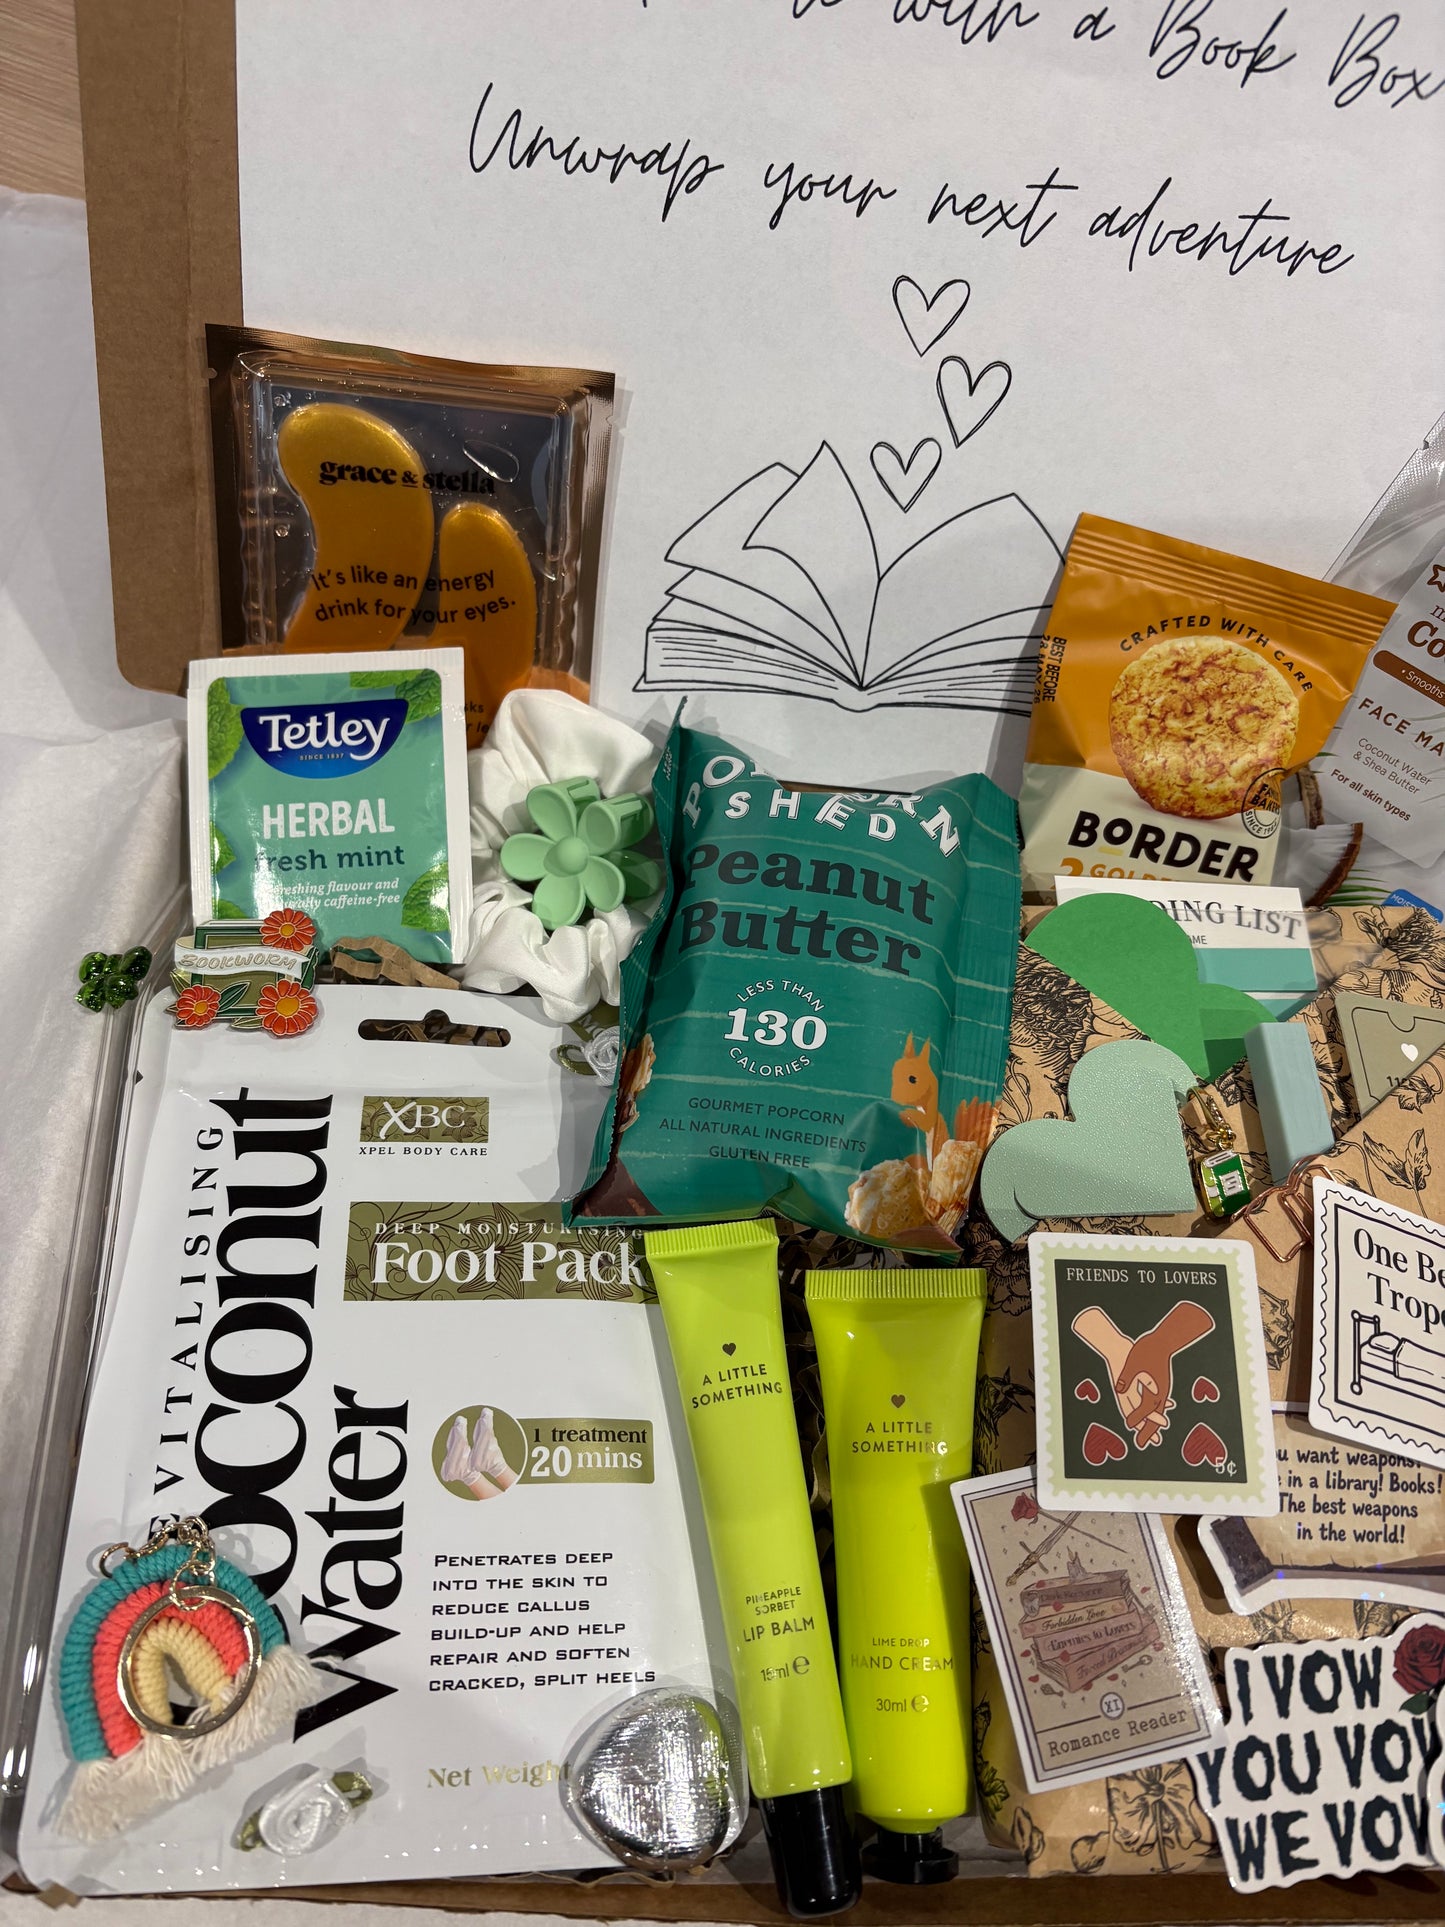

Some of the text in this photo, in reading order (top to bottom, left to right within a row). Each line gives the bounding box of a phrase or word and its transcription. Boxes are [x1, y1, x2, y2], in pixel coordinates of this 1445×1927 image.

[1072, 6, 1116, 41] a
[1149, 0, 1298, 88] Book
[1328, 13, 1445, 108] Box
[469, 82, 1354, 277] Unwrap your next adventure
[319, 461, 496, 495] grace & stella
[350, 565, 388, 584] like
[393, 573, 418, 589] an
[425, 569, 495, 592] energy
[315, 595, 516, 626] drink for your eyes.
[1119, 615, 1313, 692] CRAFTED WITH CARE
[1042, 636, 1067, 702] BEST BEFORE
[1406, 670, 1445, 699] Smooths
[1358, 698, 1411, 735] FACE
[259, 711, 391, 761] Tetley
[1353, 751, 1421, 795] & Shea Butter
[1358, 738, 1433, 786] Coconut Water
[1331, 768, 1412, 821] For all skin types
[262, 798, 395, 840] HERBAL
[1245, 810, 1263, 834] SINCE
[336, 845, 405, 869] mint
[1067, 810, 1260, 883] BORDER
[327, 880, 373, 895] flavour
[375, 877, 400, 889] and
[687, 843, 935, 925] Peanut
[324, 893, 400, 909] caffeine-free
[1234, 904, 1301, 940] LIST
[678, 899, 922, 977] Butter
[736, 980, 825, 1012] LESS THAN
[724, 1007, 828, 1050] 130
[730, 1047, 811, 1077] CALORIES
[378, 1100, 466, 1140] XBC
[688, 1097, 845, 1125] GOURMET POPCORN
[659, 1118, 867, 1153] ALL NATURAL INGREDIENTS
[358, 1146, 488, 1156] XPEL BODY CARE
[709, 1145, 811, 1169] GLUTEN FREE
[375, 1222, 441, 1235] DEEP
[370, 1241, 650, 1287] Foot Pack
[1353, 1228, 1408, 1273] One
[1067, 1267, 1217, 1285] FRIENDS TO LOVERS
[148, 1126, 224, 1541] EVITALISING
[178, 1087, 334, 1650] oconut
[702, 1363, 768, 1387] A LITTLE
[692, 1381, 783, 1409] SOMETHING
[533, 1426, 647, 1443] 1 treatment
[865, 1421, 933, 1434] A LITTLE
[530, 1446, 643, 1477] 20 mins
[852, 1440, 948, 1455] SOMETHING
[1296, 1447, 1339, 1465] want
[1287, 1470, 1303, 1488] in
[1309, 1476, 1319, 1489] a
[1326, 1470, 1384, 1498] library!
[1389, 1472, 1443, 1494] Books!
[1312, 1493, 1347, 1515] best
[1352, 1501, 1419, 1522] weapons
[1296, 1521, 1405, 1544] in the world!
[293, 1384, 409, 1744] Water
[565, 1552, 614, 1564] DEEP
[433, 1575, 608, 1591] INTO THE SKIN TO
[745, 1586, 802, 1605] PINEAPPLE
[432, 1600, 591, 1616] REDUCE CALLUS
[755, 1600, 796, 1616] SORBET
[431, 1623, 626, 1641] BUILD-UP AND HELP
[742, 1616, 815, 1642] LIP BALM
[872, 1637, 930, 1648] LIME DROP
[430, 1648, 631, 1666] REPAIR AND SOFTEN
[851, 1654, 954, 1672] HAND CREAM
[429, 1671, 656, 1691] CRACKED, SPLIT HEELS
[1233, 1646, 1382, 1727] I VOW
[876, 1698, 907, 1713] 30ml
[1104, 1698, 1122, 1714] XI
[1049, 1708, 1188, 1757] Romance Reader
[427, 1760, 571, 1788] Net Weight
[1200, 1730, 1321, 1808] YOU
[1225, 1811, 1320, 1883] WE
